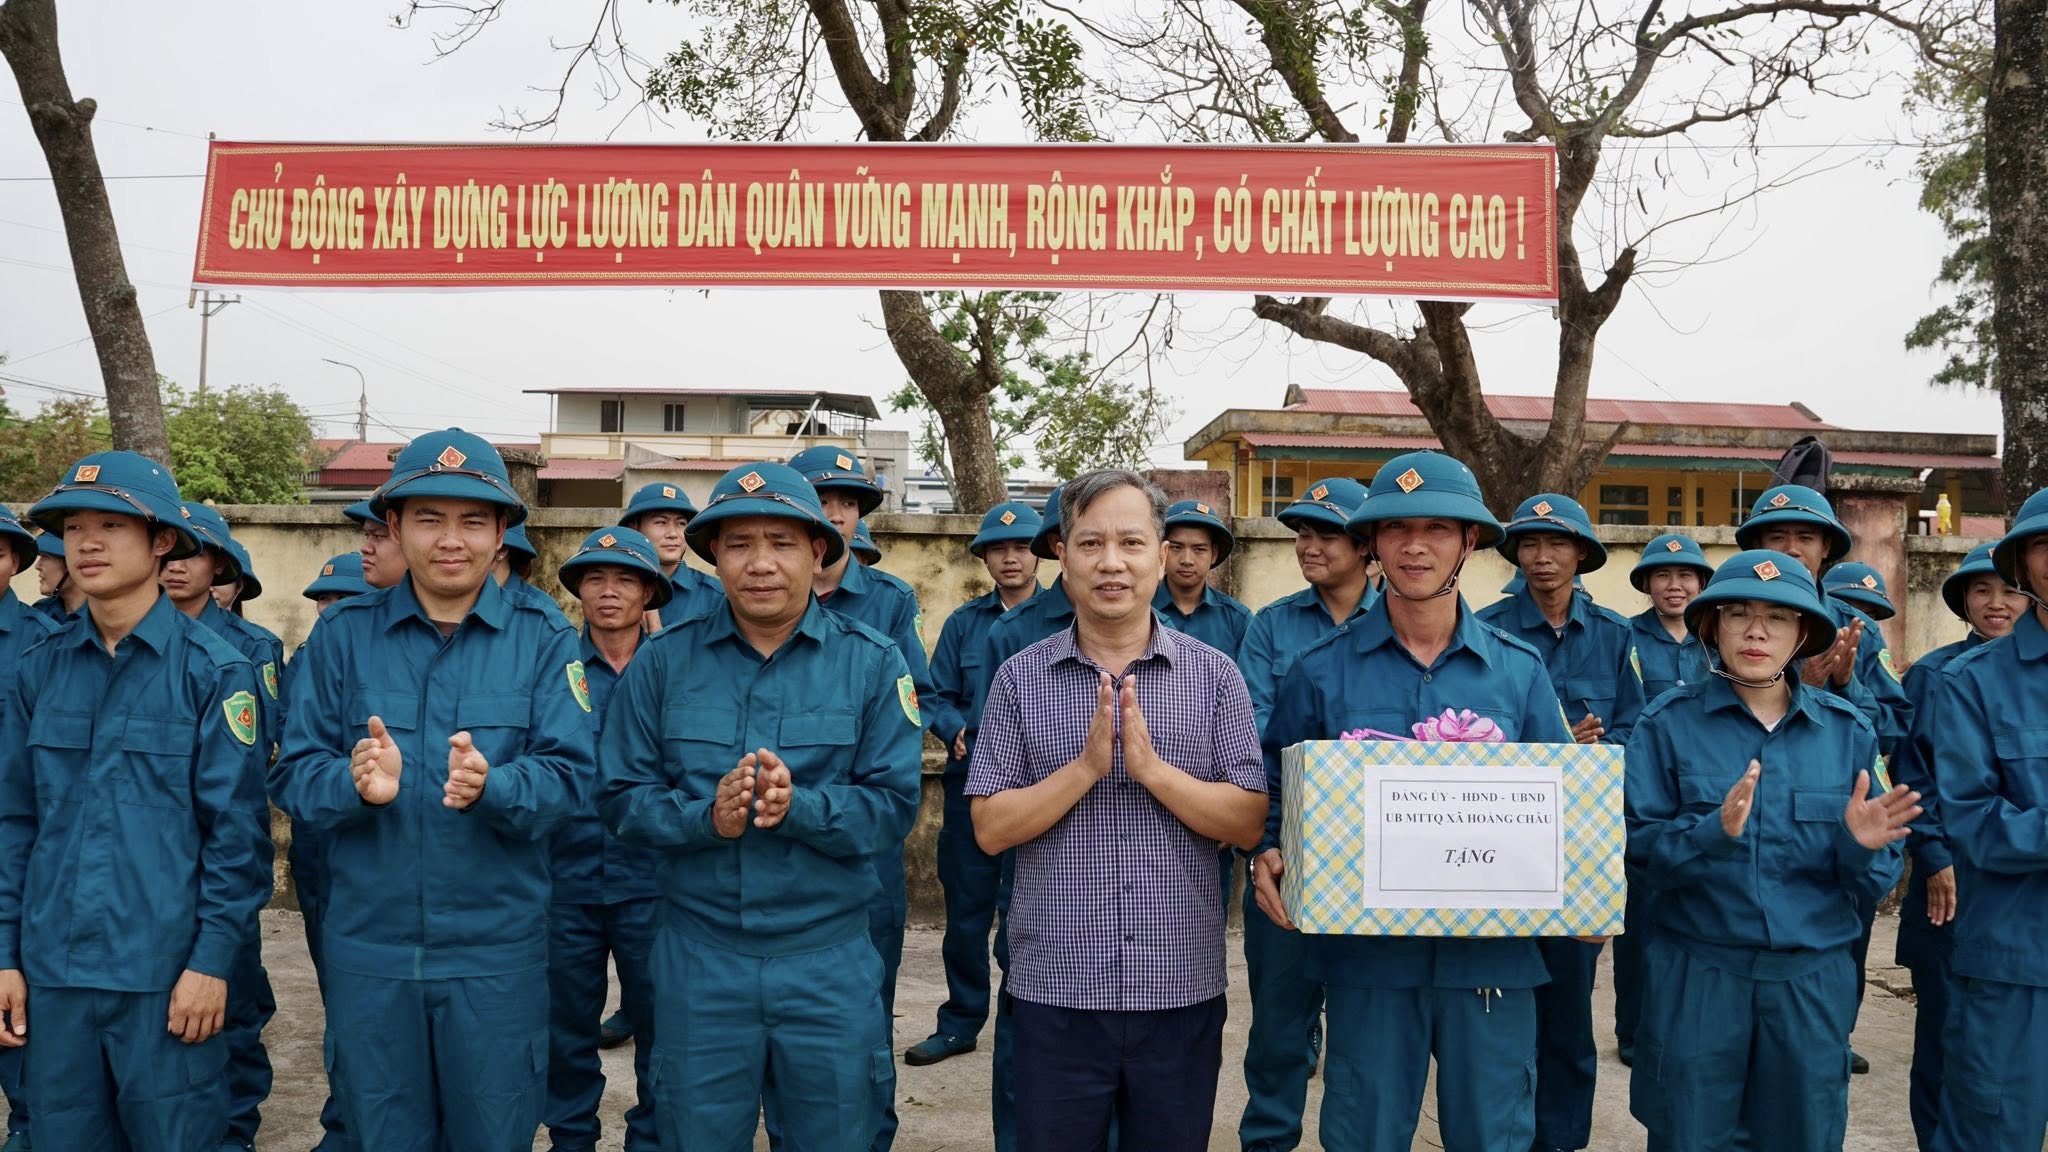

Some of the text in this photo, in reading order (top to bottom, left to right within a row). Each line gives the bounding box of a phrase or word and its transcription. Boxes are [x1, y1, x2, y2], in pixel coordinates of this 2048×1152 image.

[228, 162, 1526, 273] CHỦ ĐỘNG XÂY DỰNG LỰC LƯỢNG DÂN QUÂN VỮNG MẠNH, RỘNG KHẮP, CÓ CHẤT LƯỢNG CAO !
[1462, 792, 1498, 802] HĐND
[1511, 793, 1545, 803] UBND
[1385, 813, 1403, 823] UB
[1406, 813, 1443, 825] MTTQ
[1446, 811, 1464, 824] XÃ
[1516, 811, 1552, 824] CHÂU
[1445, 847, 1496, 867] TẶNG
